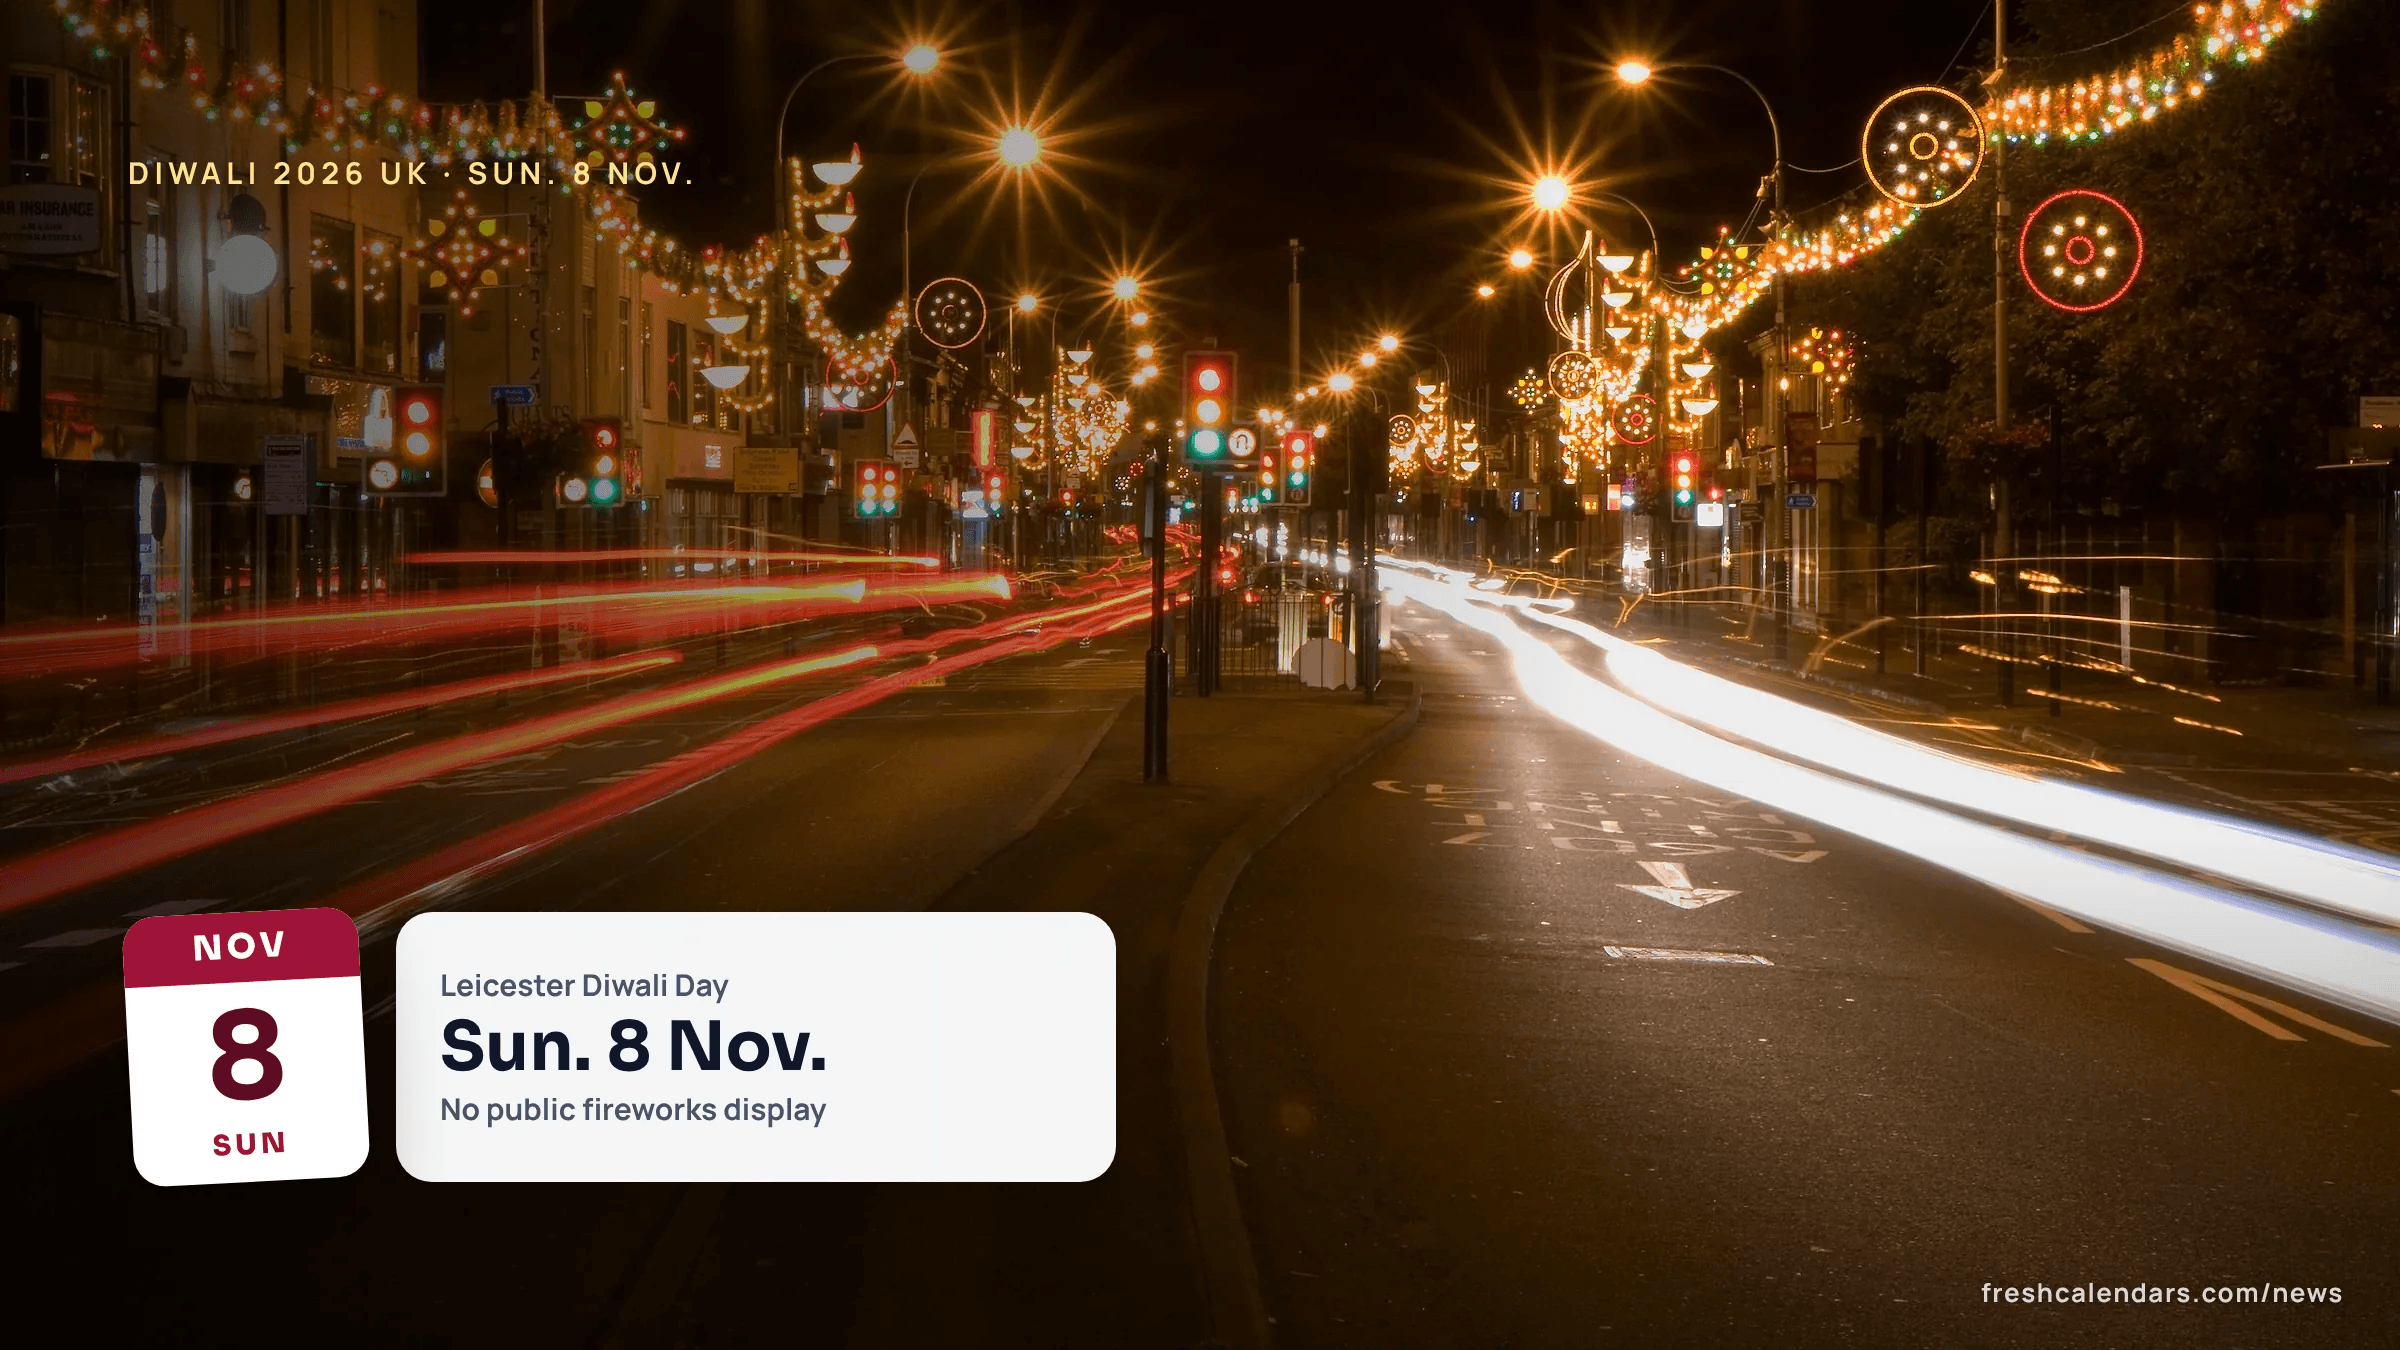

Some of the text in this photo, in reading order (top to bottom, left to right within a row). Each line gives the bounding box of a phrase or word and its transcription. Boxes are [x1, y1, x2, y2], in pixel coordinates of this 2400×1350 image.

[20, 201, 94, 217] INSURANCE
[511, 404, 572, 425] CRATS
[1441, 830, 1829, 863] A607
